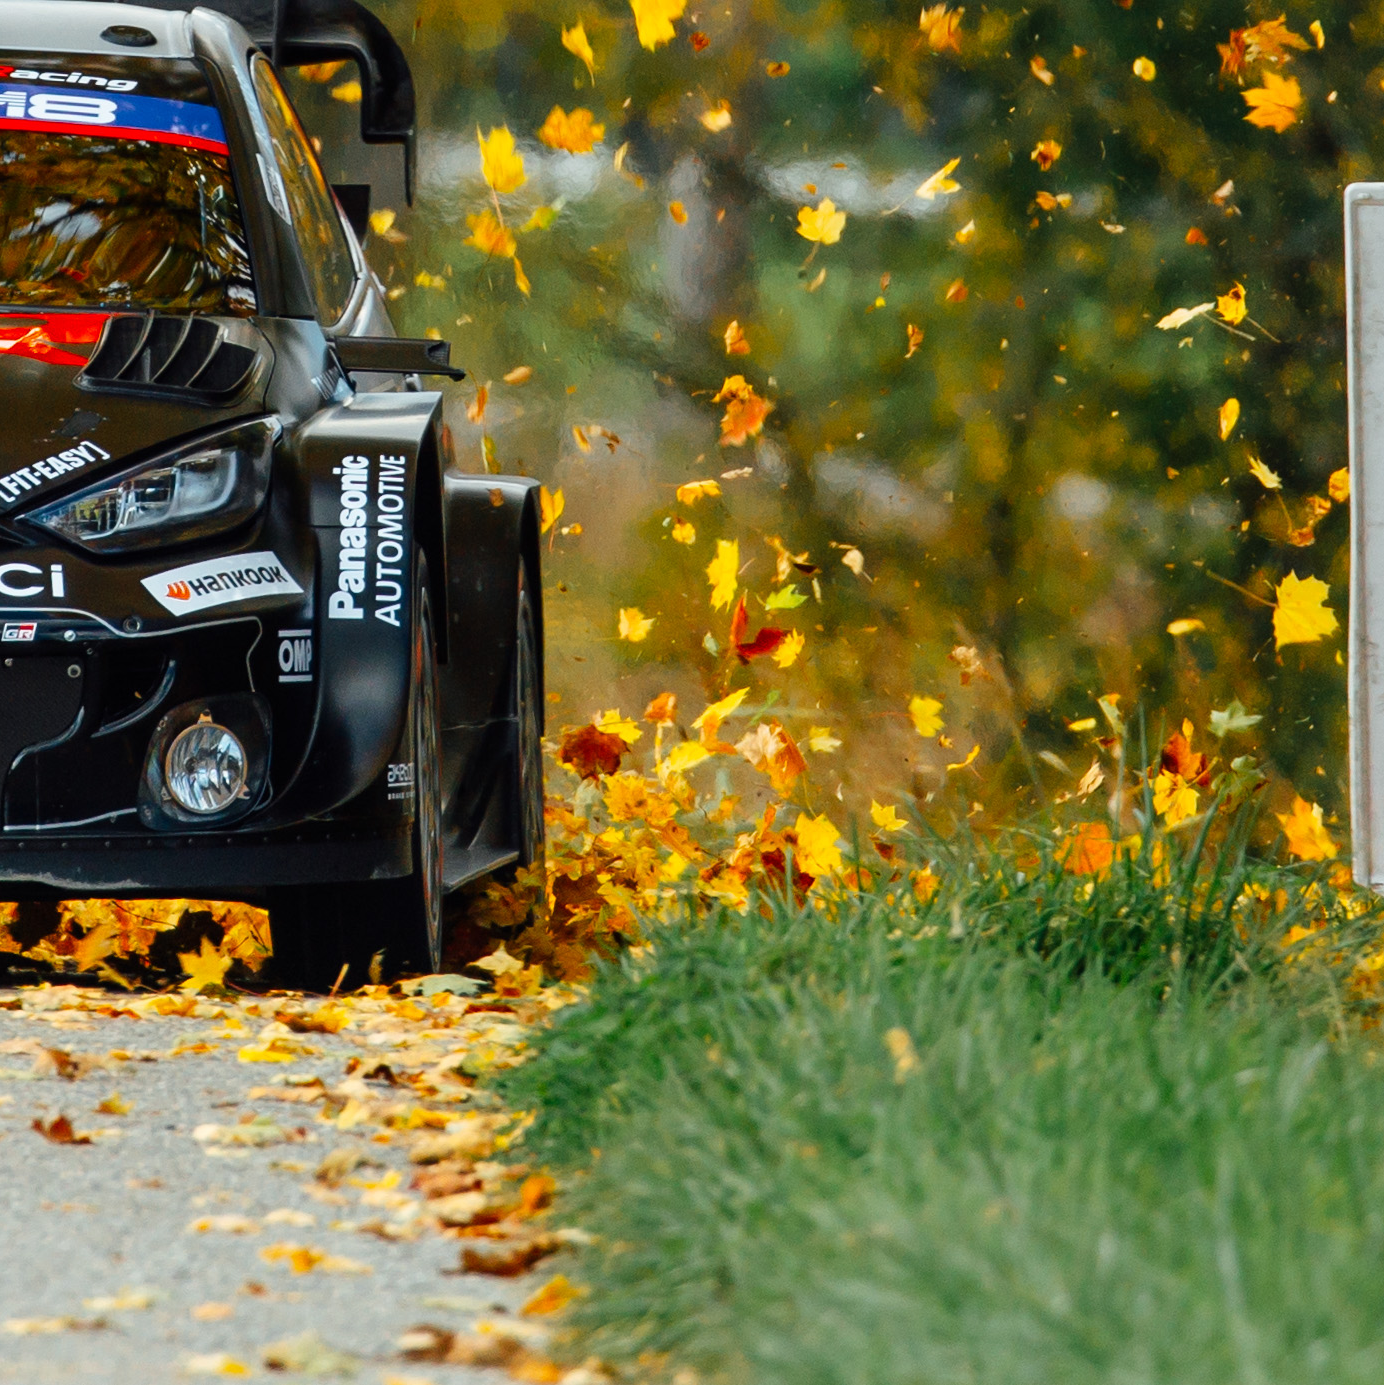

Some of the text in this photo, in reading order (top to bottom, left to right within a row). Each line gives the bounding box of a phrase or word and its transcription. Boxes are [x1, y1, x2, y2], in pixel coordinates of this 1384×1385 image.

[328, 454, 371, 620] Panasonic
[374, 454, 406, 627] AUTOMOTIVE
[279, 639, 312, 672] OMP
